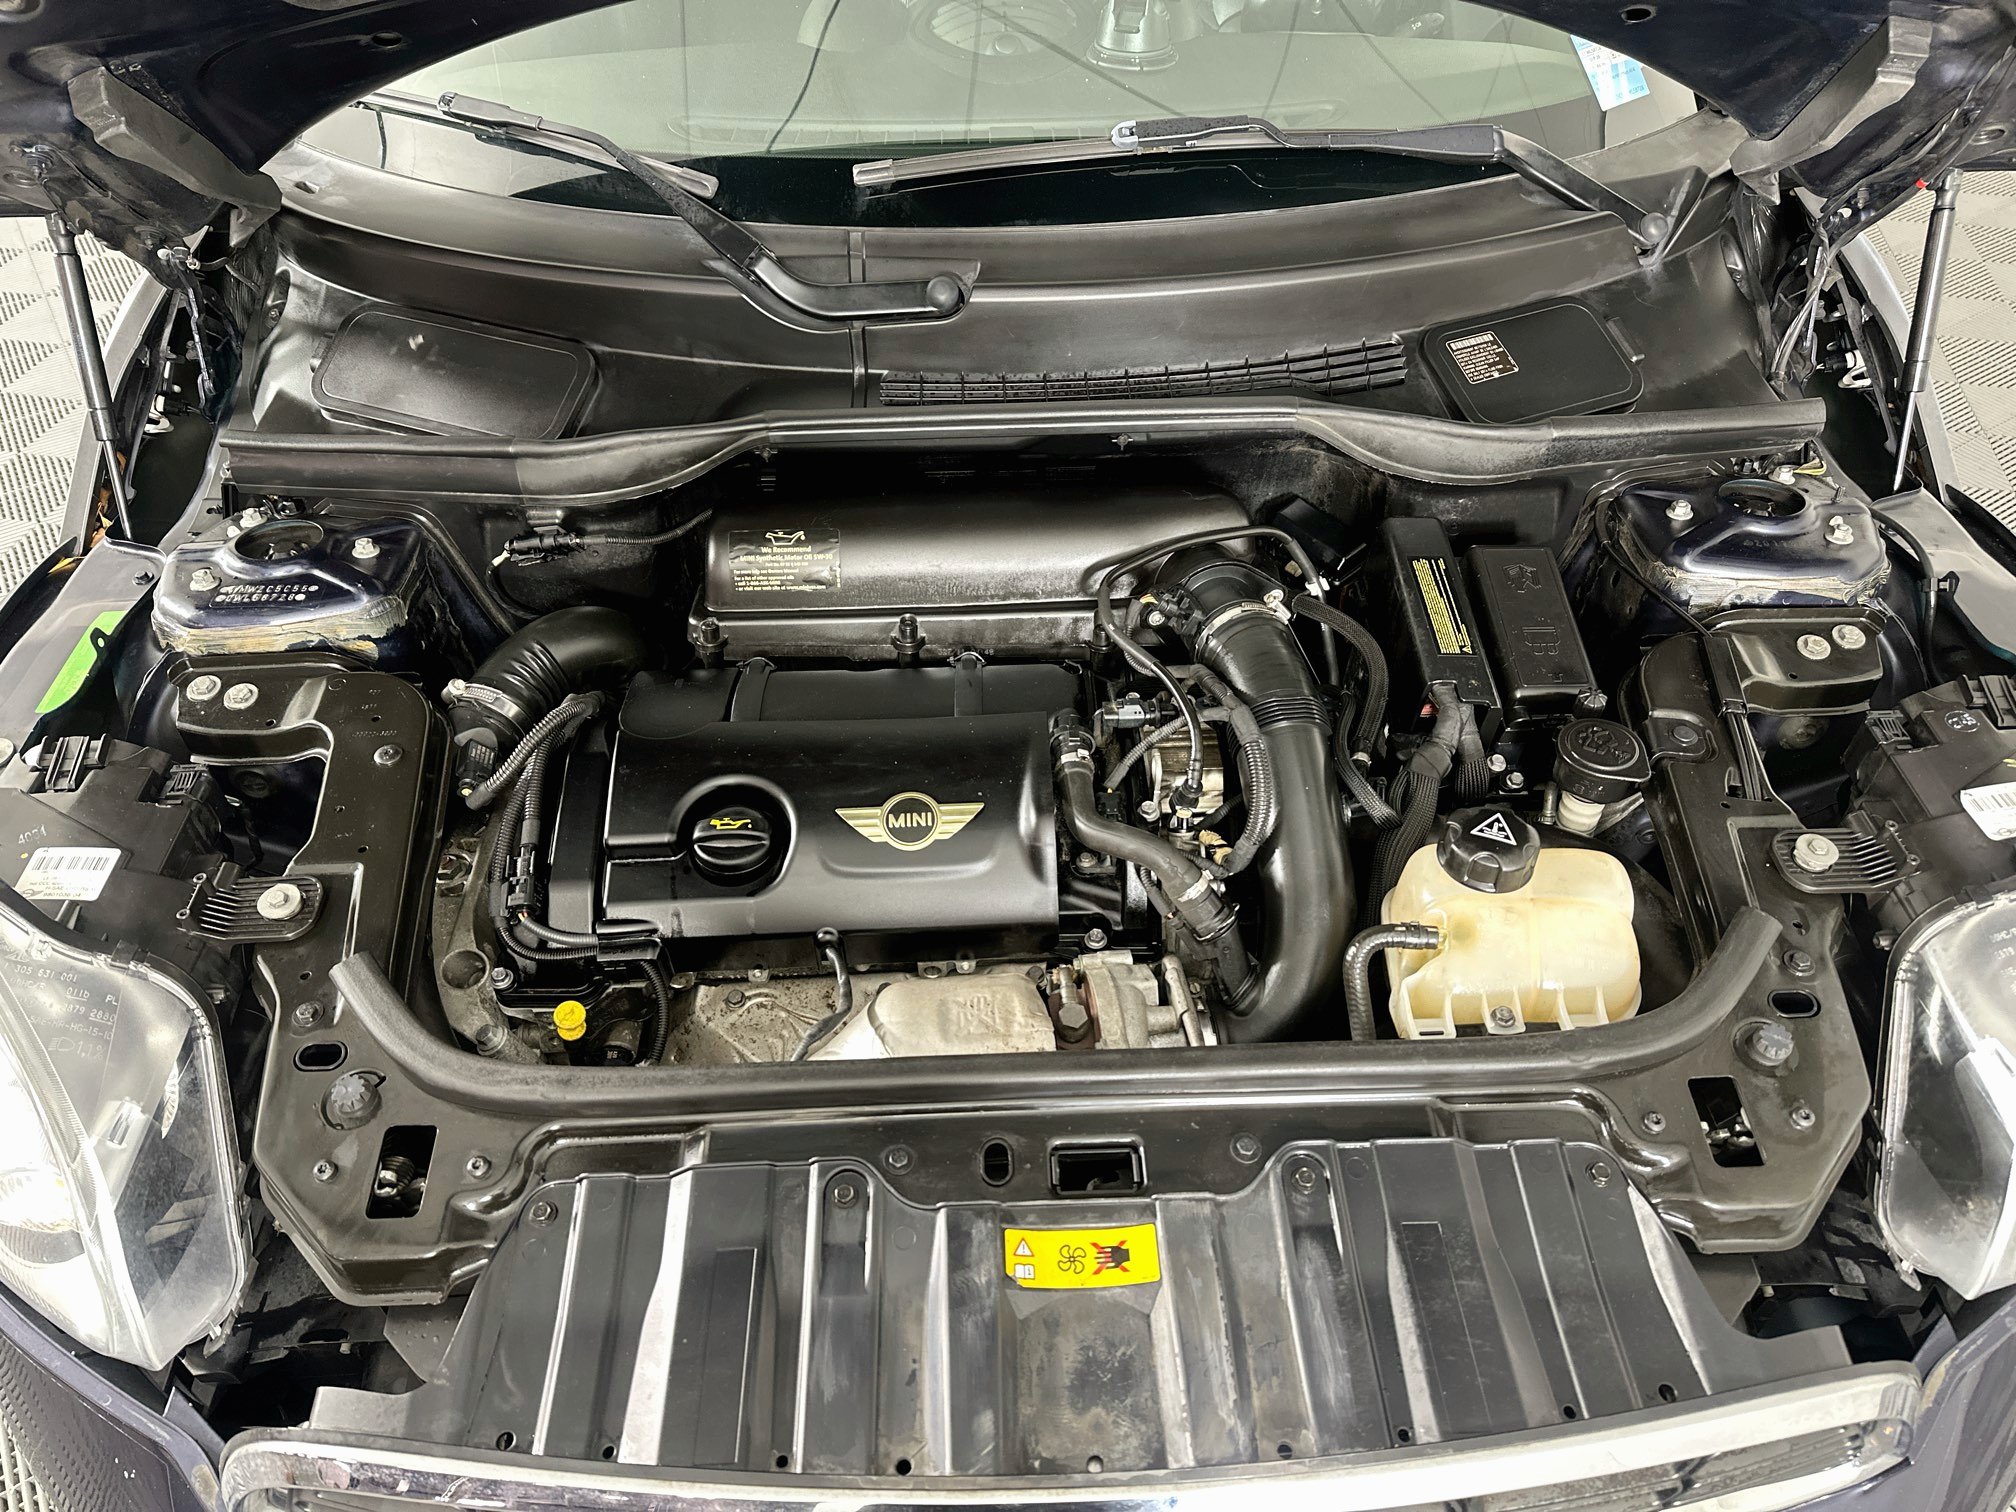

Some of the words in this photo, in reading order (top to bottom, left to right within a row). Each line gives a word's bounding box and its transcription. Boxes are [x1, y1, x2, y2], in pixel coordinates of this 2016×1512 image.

[773, 545, 811, 553] Recommend
[756, 554, 783, 563] Synthetic
[888, 812, 932, 828] MINI
[14, 964, 33, 975] 305
[37, 968, 54, 979] 631
[60, 972, 78, 982] 001
[105, 994, 118, 1005] PL
